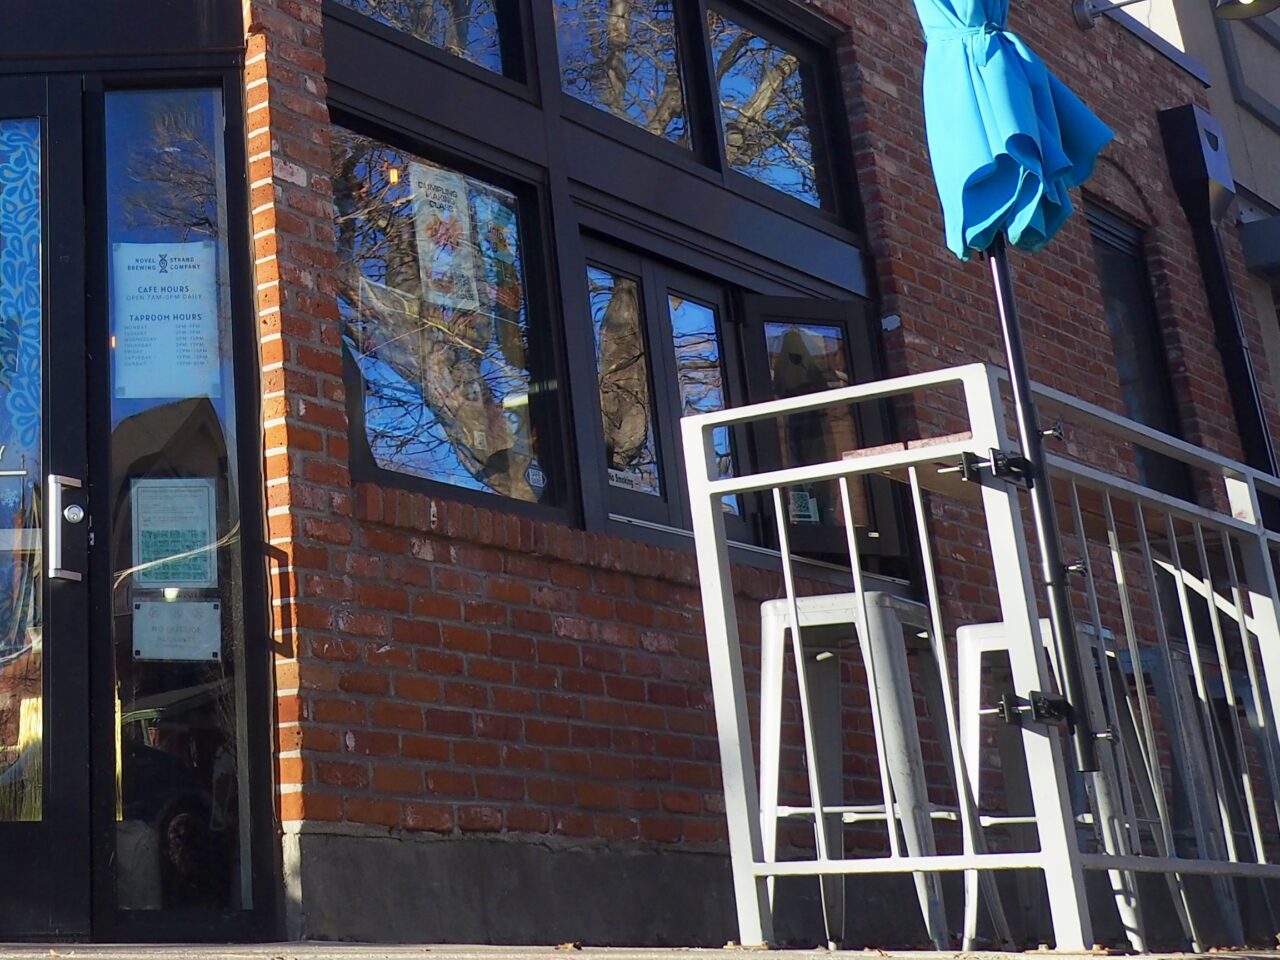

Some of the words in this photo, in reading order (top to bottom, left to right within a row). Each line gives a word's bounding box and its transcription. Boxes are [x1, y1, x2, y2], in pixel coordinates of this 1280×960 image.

[137, 286, 158, 294] CAFE
[160, 285, 190, 293] HOURS
[129, 314, 170, 322] TAPROOM
[172, 313, 203, 321] HOURS
